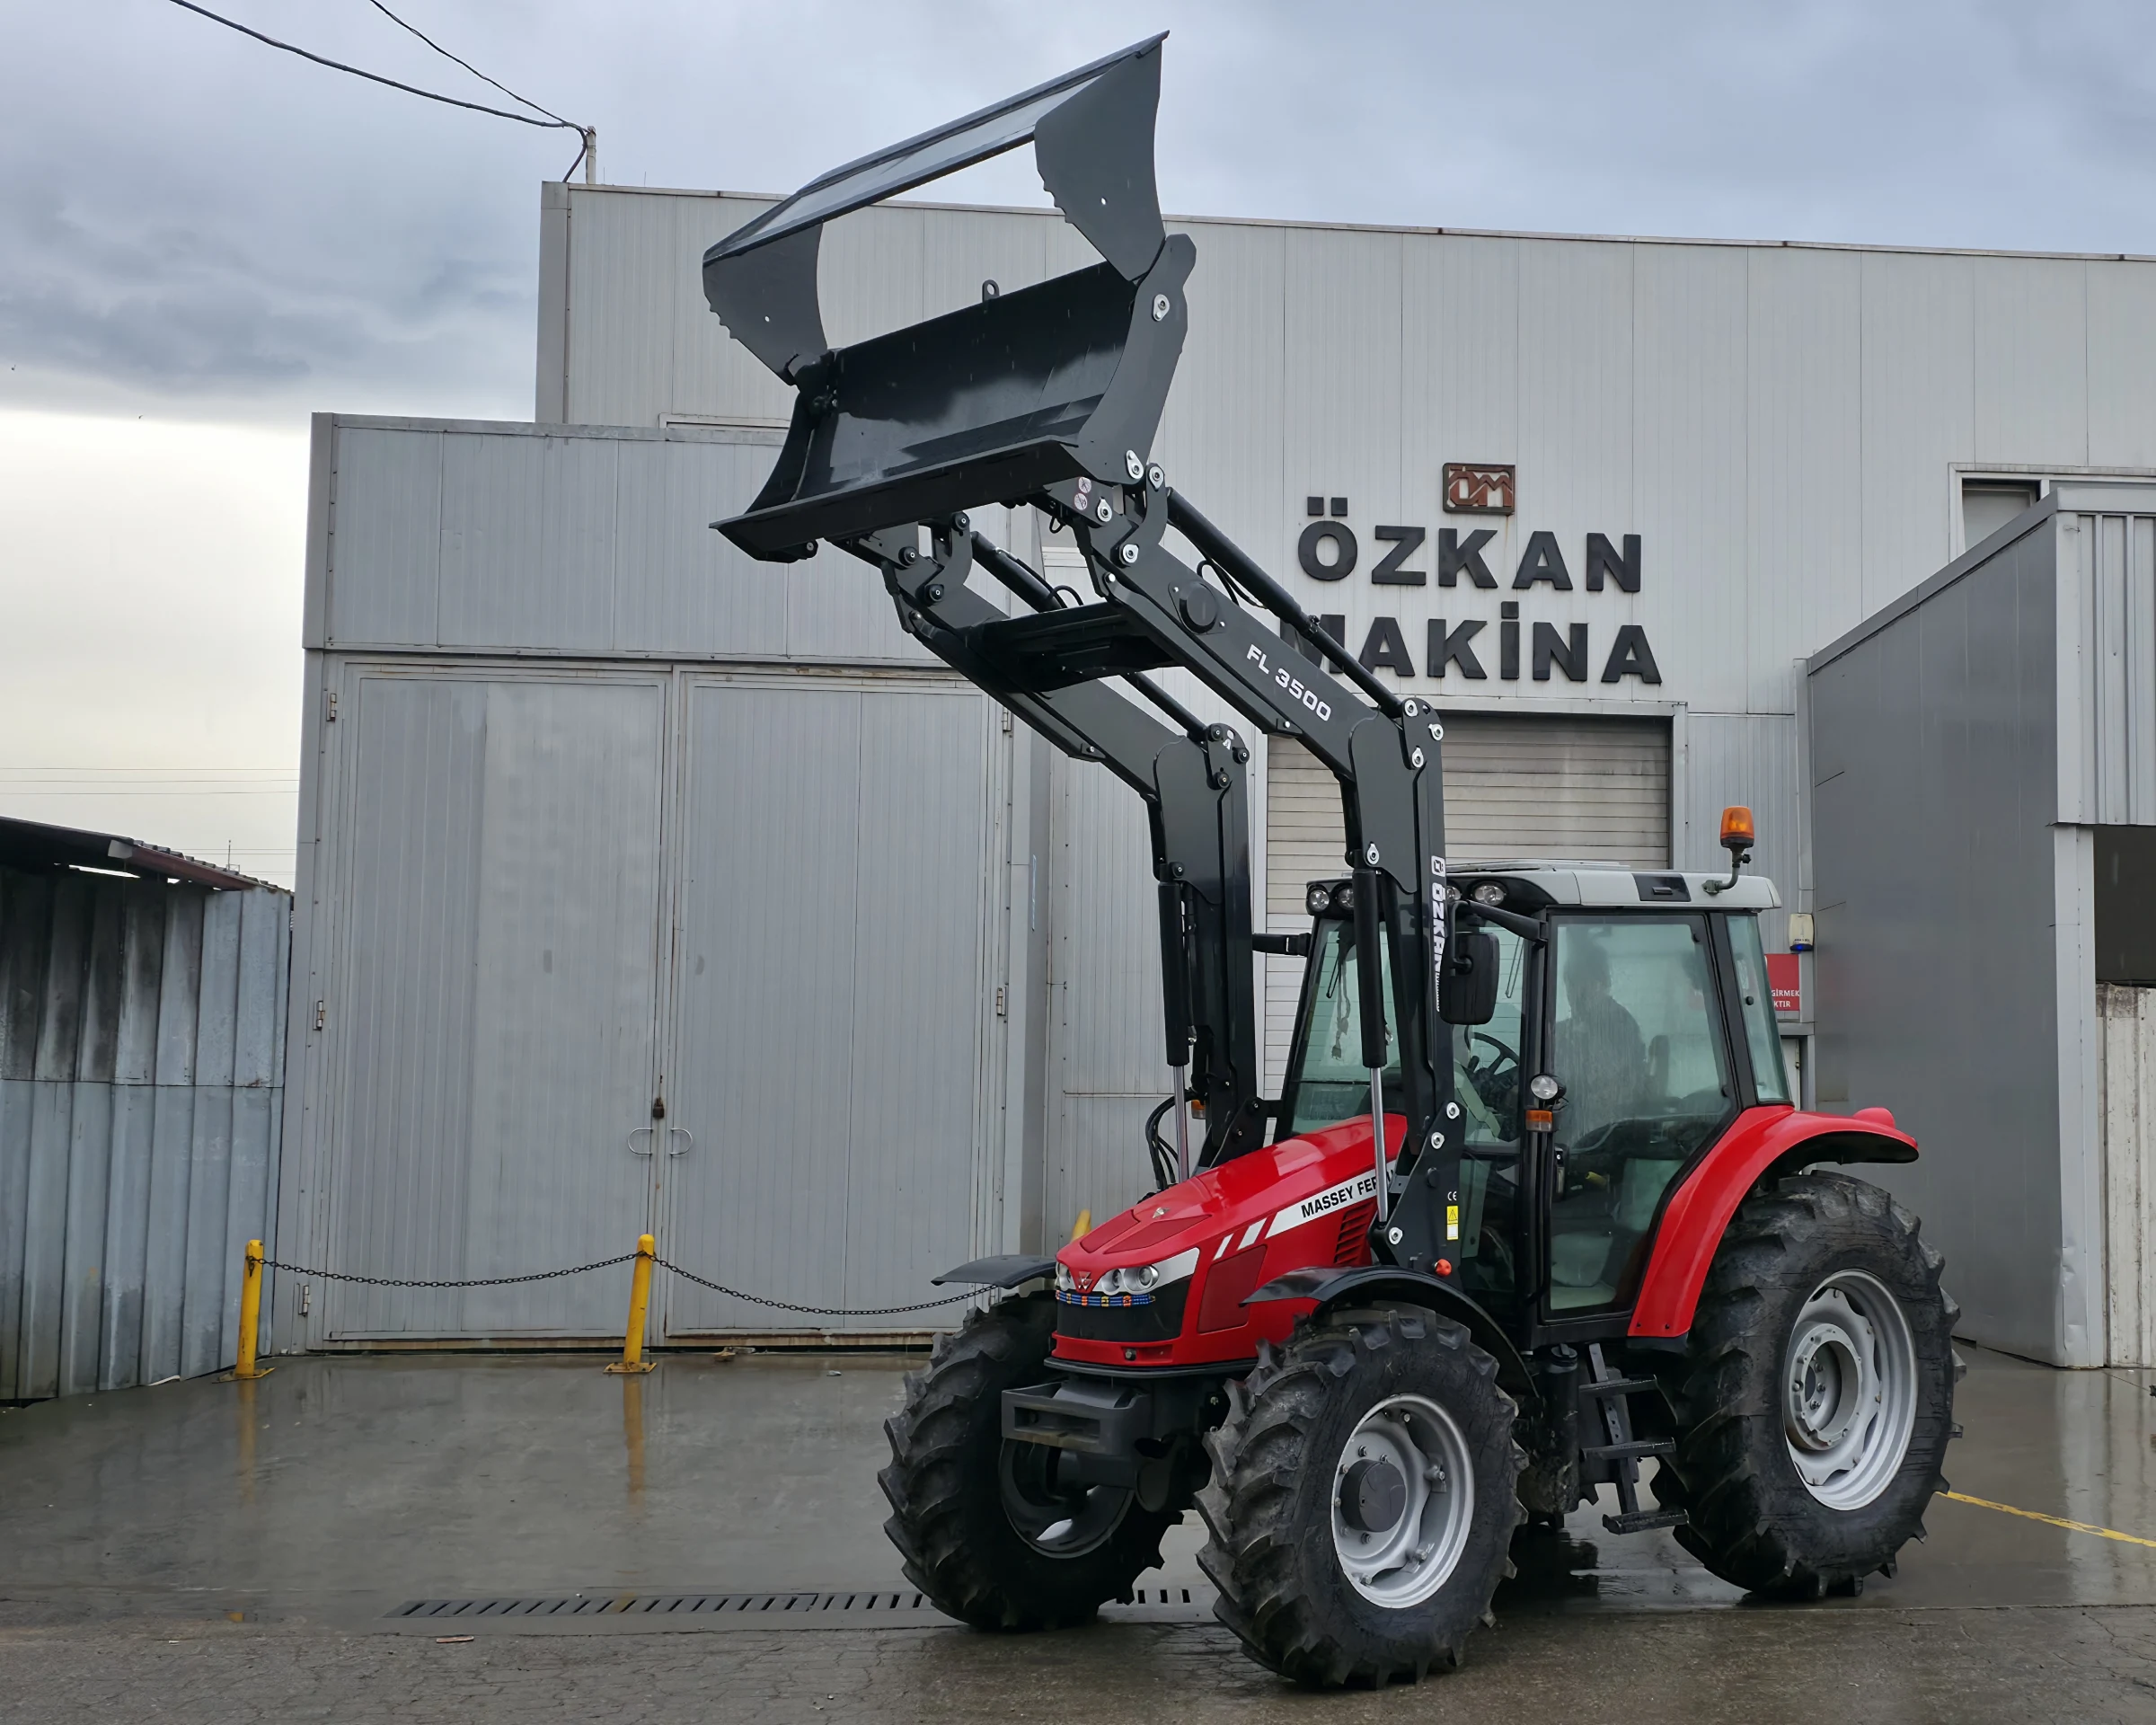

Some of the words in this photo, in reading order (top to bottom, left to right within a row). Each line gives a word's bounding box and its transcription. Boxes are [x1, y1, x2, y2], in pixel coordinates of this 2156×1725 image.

[1297, 496, 1642, 593] ÖZKAN
[1247, 643, 1269, 675] FL
[1275, 668, 1331, 721] 3500
[1301, 1185, 1353, 1218] MASSEY
[1447, 1190, 1457, 1201] CE
